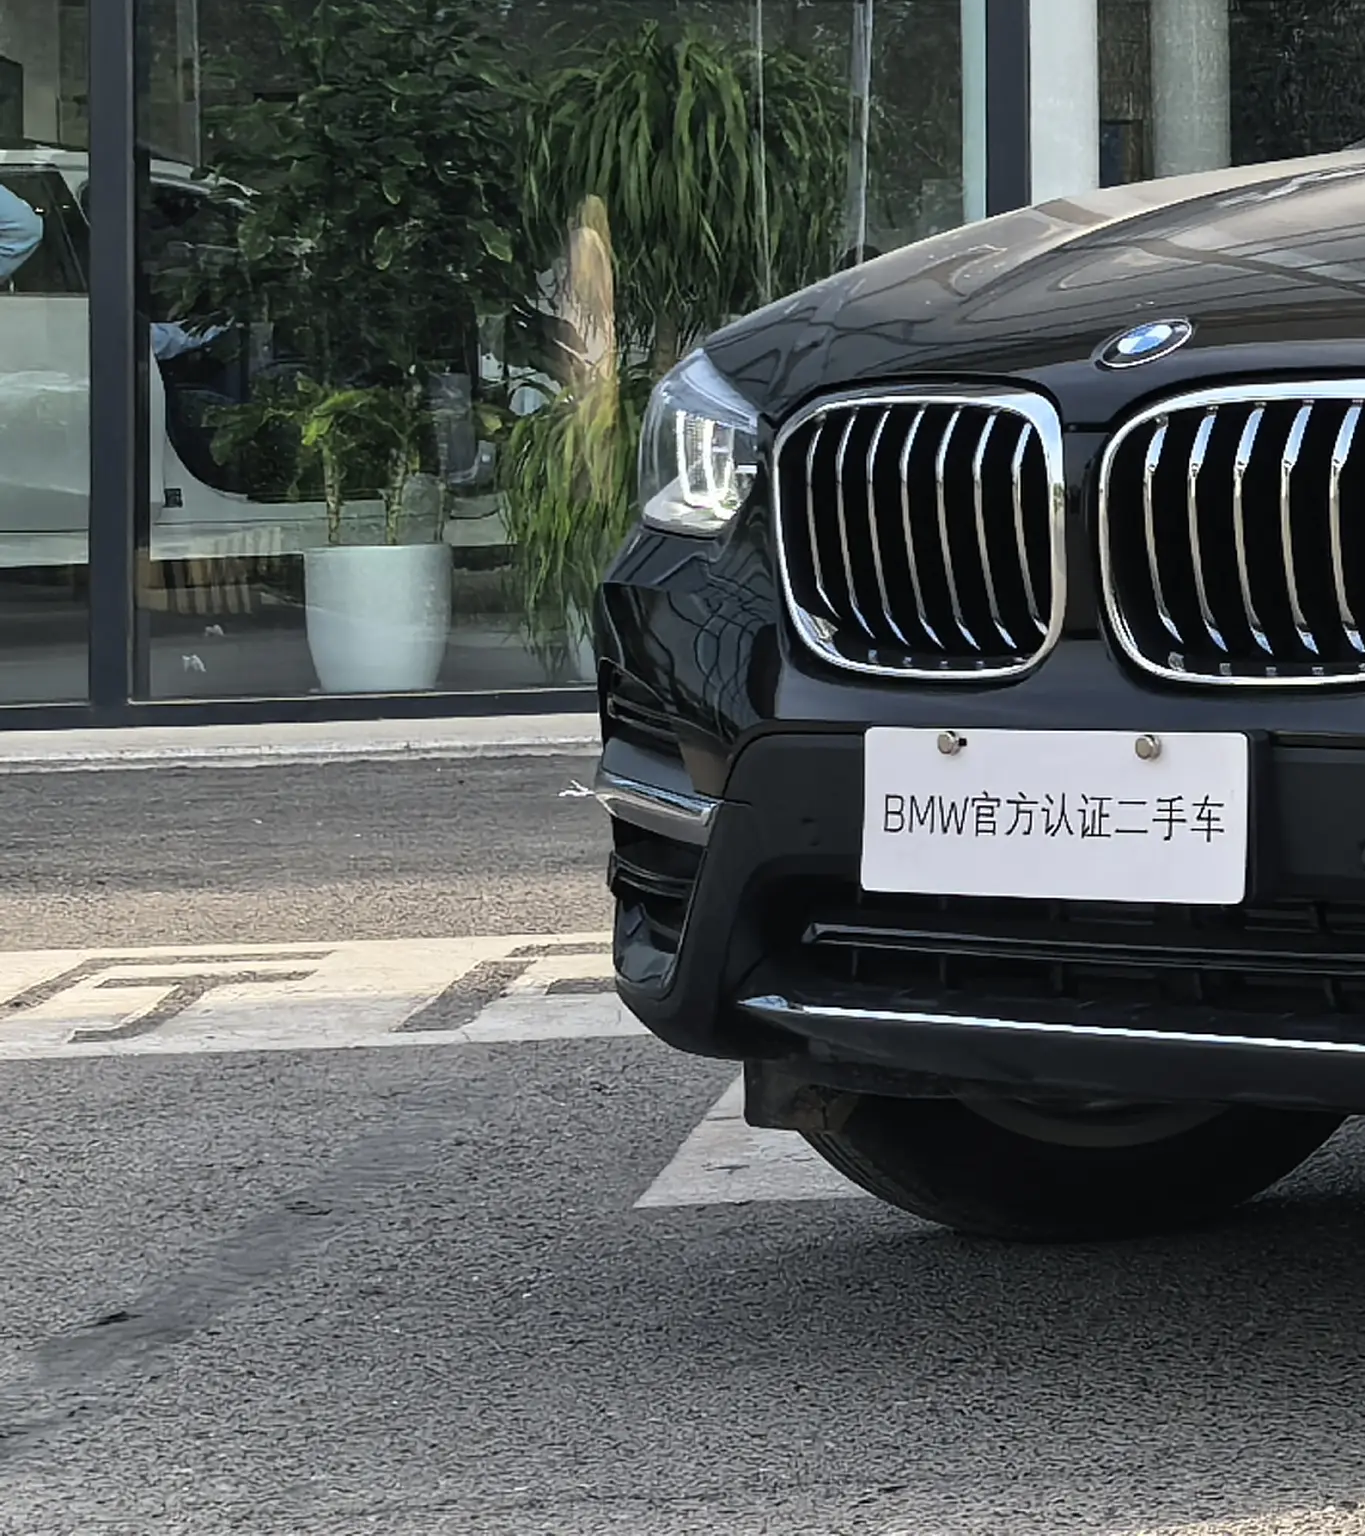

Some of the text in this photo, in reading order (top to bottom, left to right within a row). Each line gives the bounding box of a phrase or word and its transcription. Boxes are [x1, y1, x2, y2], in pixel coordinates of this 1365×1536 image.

[883, 791, 1225, 843] BMW官方认证二手车
